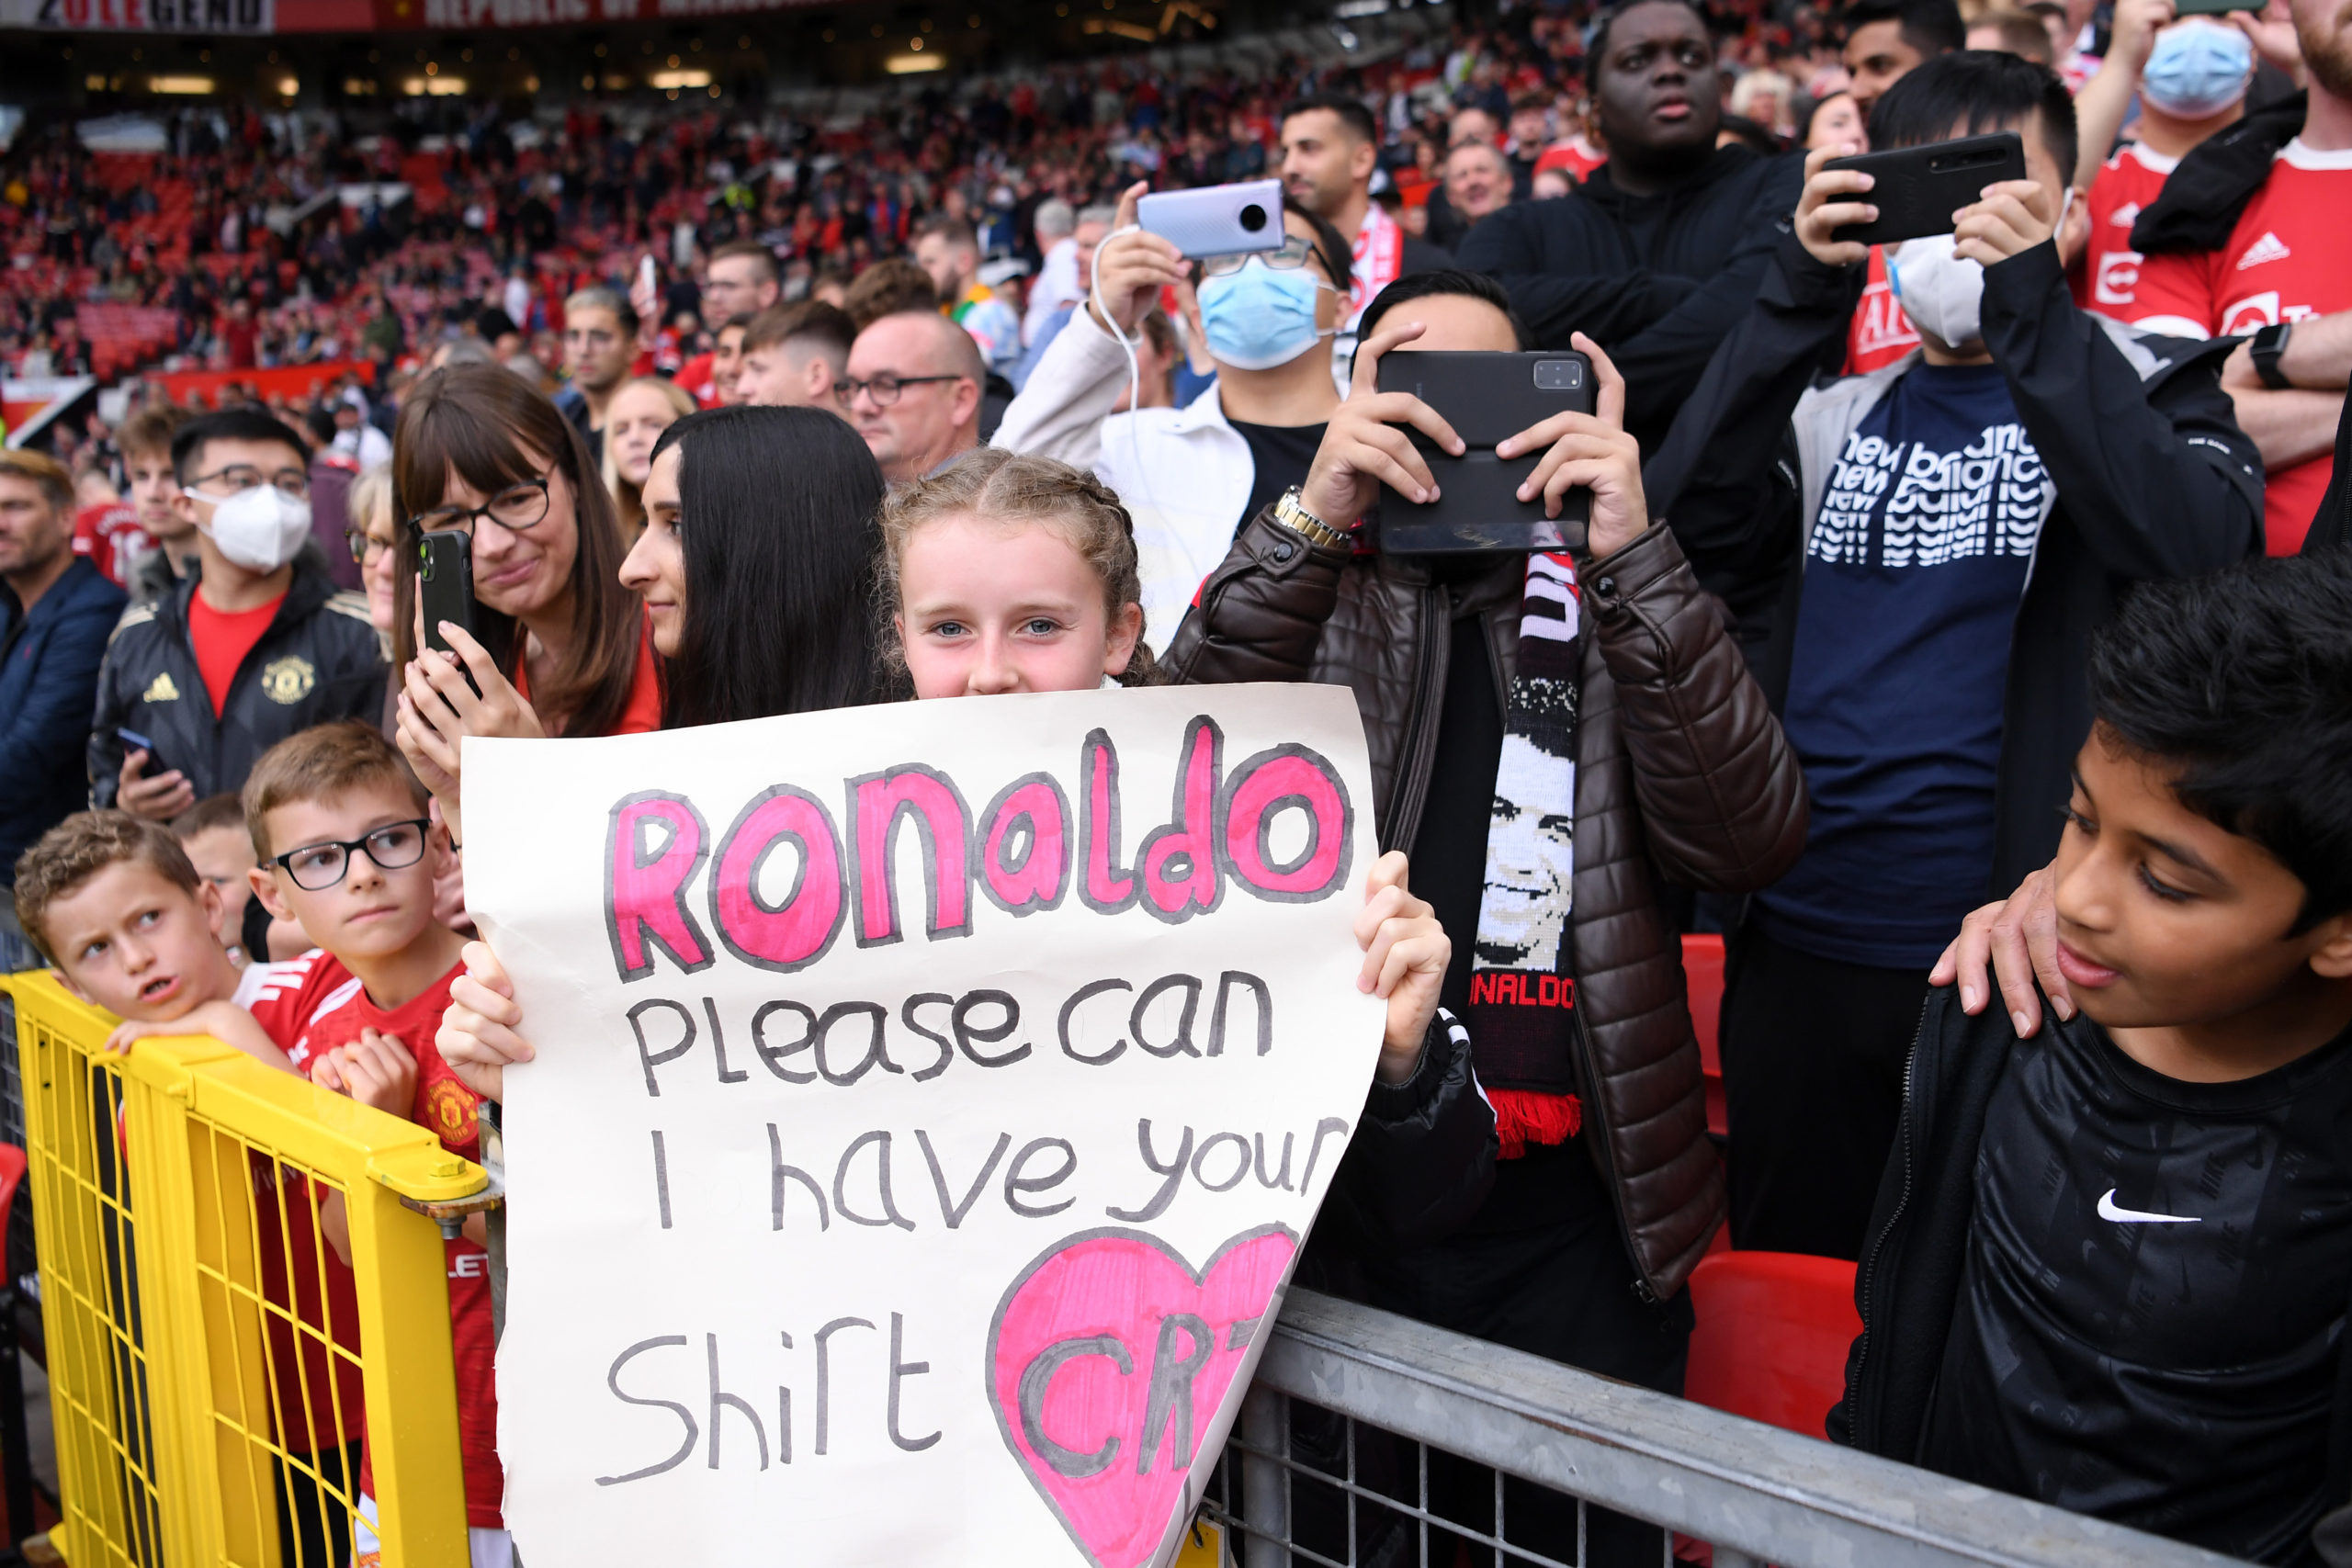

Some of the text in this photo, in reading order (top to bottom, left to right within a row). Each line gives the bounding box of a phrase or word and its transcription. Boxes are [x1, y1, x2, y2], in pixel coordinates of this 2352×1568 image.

[1858, 294, 1916, 345] AI
[1469, 973, 1574, 1010] NALDO
[766, 1122, 1076, 1233] have
[1105, 1117, 1349, 1224] your
